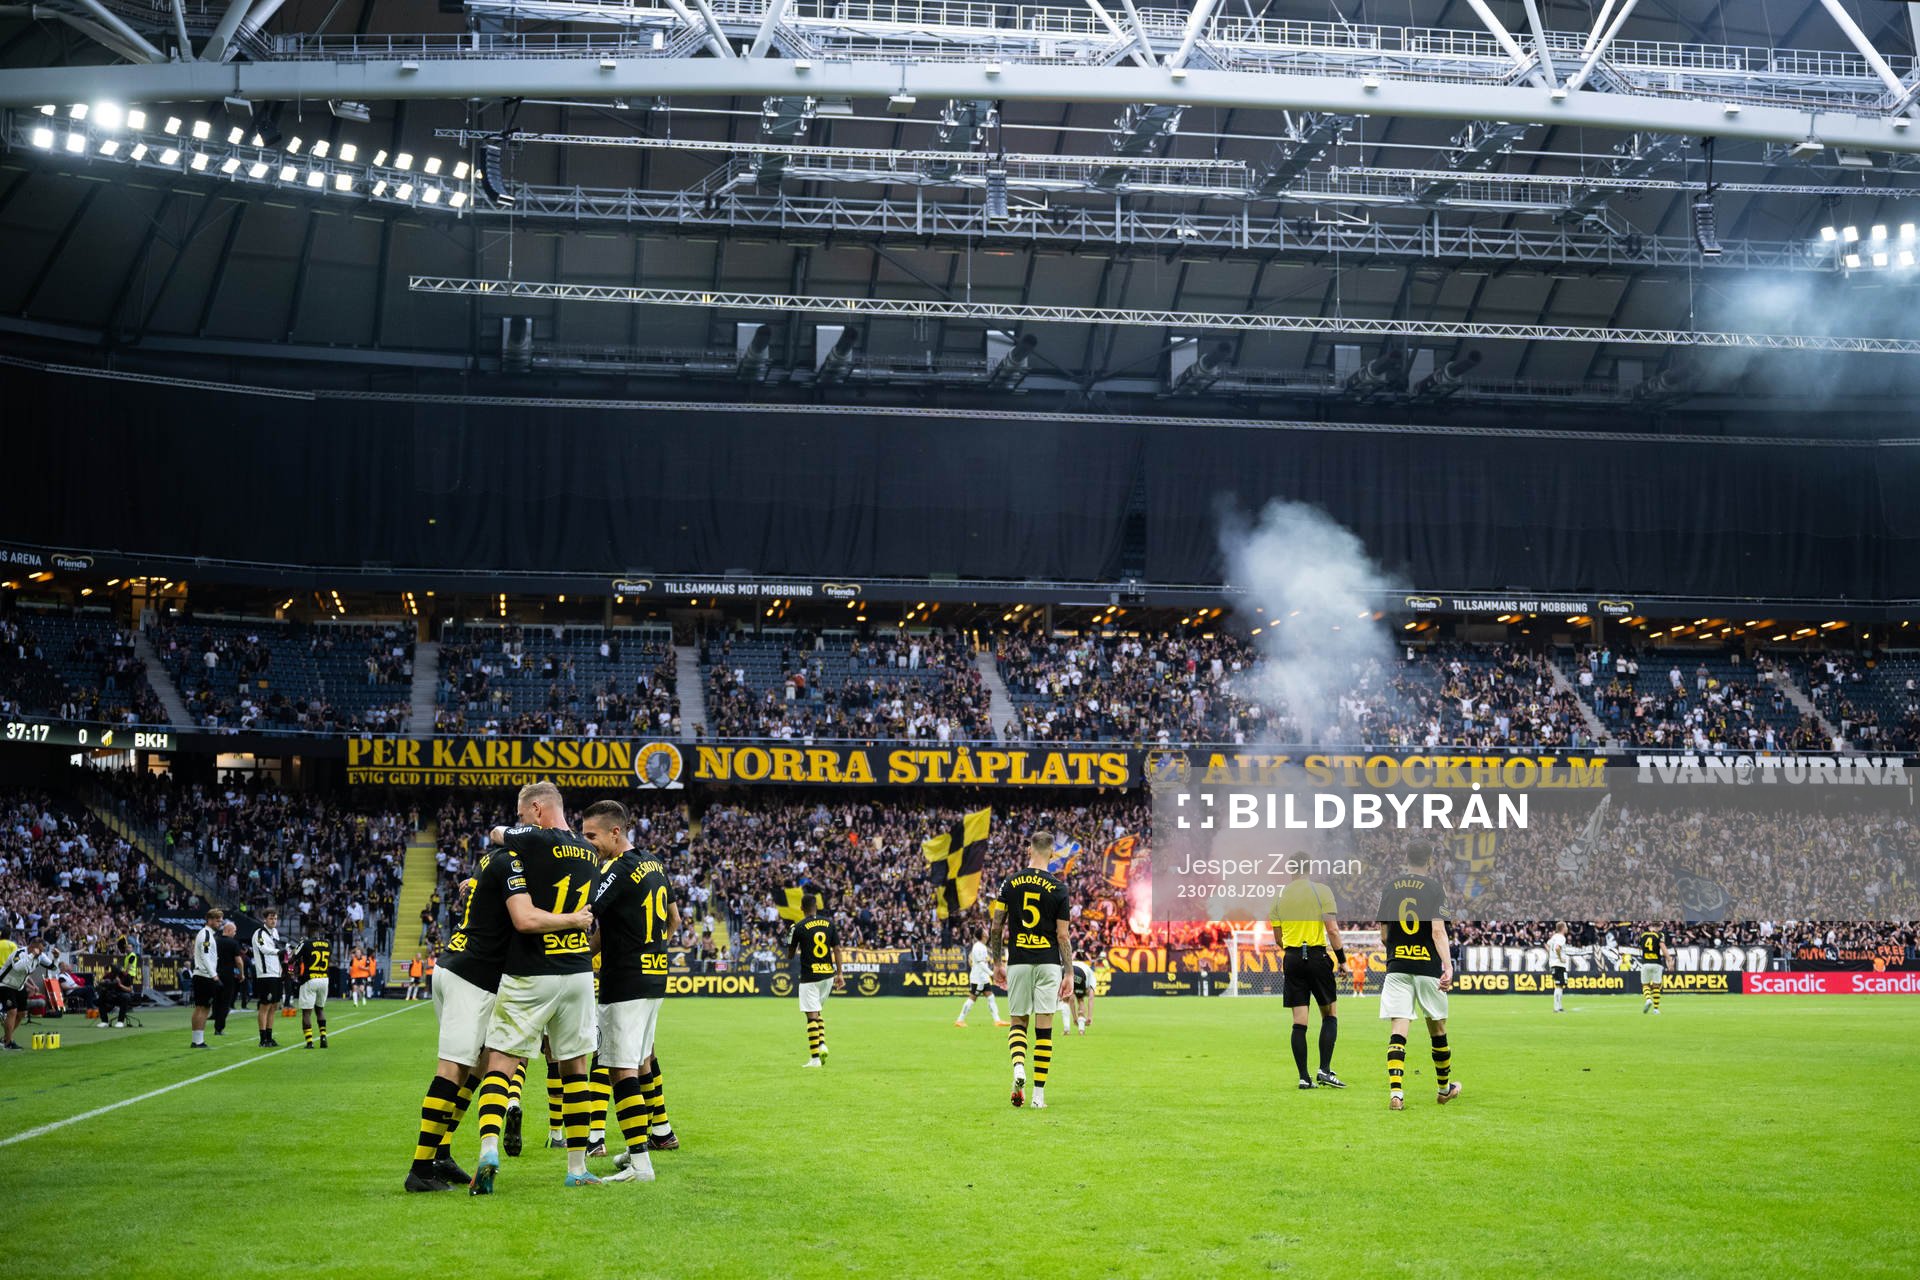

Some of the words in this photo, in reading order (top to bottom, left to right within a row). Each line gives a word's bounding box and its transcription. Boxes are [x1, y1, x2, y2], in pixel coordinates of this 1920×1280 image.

[10, 552, 42, 566] ARENA
[57, 559, 87, 569] friends
[618, 583, 647, 592] friends
[664, 583, 735, 595] TILLSAMMANS
[738, 584, 760, 595] MOT
[761, 585, 813, 596] MOBBNING
[828, 587, 856, 597] friends
[1453, 600, 1518, 612] TILLSAMMANS
[1520, 601, 1538, 612] MOT
[1541, 602, 1588, 613] MOBBNING
[1603, 604, 1629, 613] friends
[6, 722, 50, 742] 37:17
[78, 729, 88, 744] 0
[135, 732, 168, 748] BKH
[348, 739, 420, 767] PER
[432, 739, 632, 769] KARLSSON
[694, 745, 877, 783] NORRA
[888, 747, 1129, 785] STÅPLATS
[1201, 753, 1290, 788] AIK
[1304, 755, 1608, 789] STOCKHOLM
[1637, 755, 1735, 784] IVAN
[1756, 757, 1909, 785] TURINA
[349, 772, 384, 785] EVIG
[389, 772, 420, 785] GUD
[425, 773, 430, 785] I
[434, 773, 455, 786] DE
[556, 775, 629, 788] SAGORNA
[1011, 875, 1057, 893] MILOŠEVIĆ
[1394, 879, 1425, 890] HALITI
[552, 874, 592, 914] 11
[641, 886, 668, 943] 19
[1022, 891, 1041, 929] 5
[1399, 897, 1420, 935] 6
[543, 931, 591, 949] SVEA
[813, 931, 828, 958] 8
[1016, 933, 1052, 945] SVEA
[1644, 937, 1654, 952] 4
[1395, 945, 1430, 957] SVEA
[309, 951, 330, 971] 25
[641, 954, 668, 969] SVE
[922, 972, 969, 986] TISAB
[1450, 974, 1509, 990] -BYGG
[1515, 974, 1536, 989] ICA
[1539, 973, 1624, 992] Jäastaden
[1662, 974, 1728, 988] KAPPEX
[1750, 974, 1826, 993] Scandic
